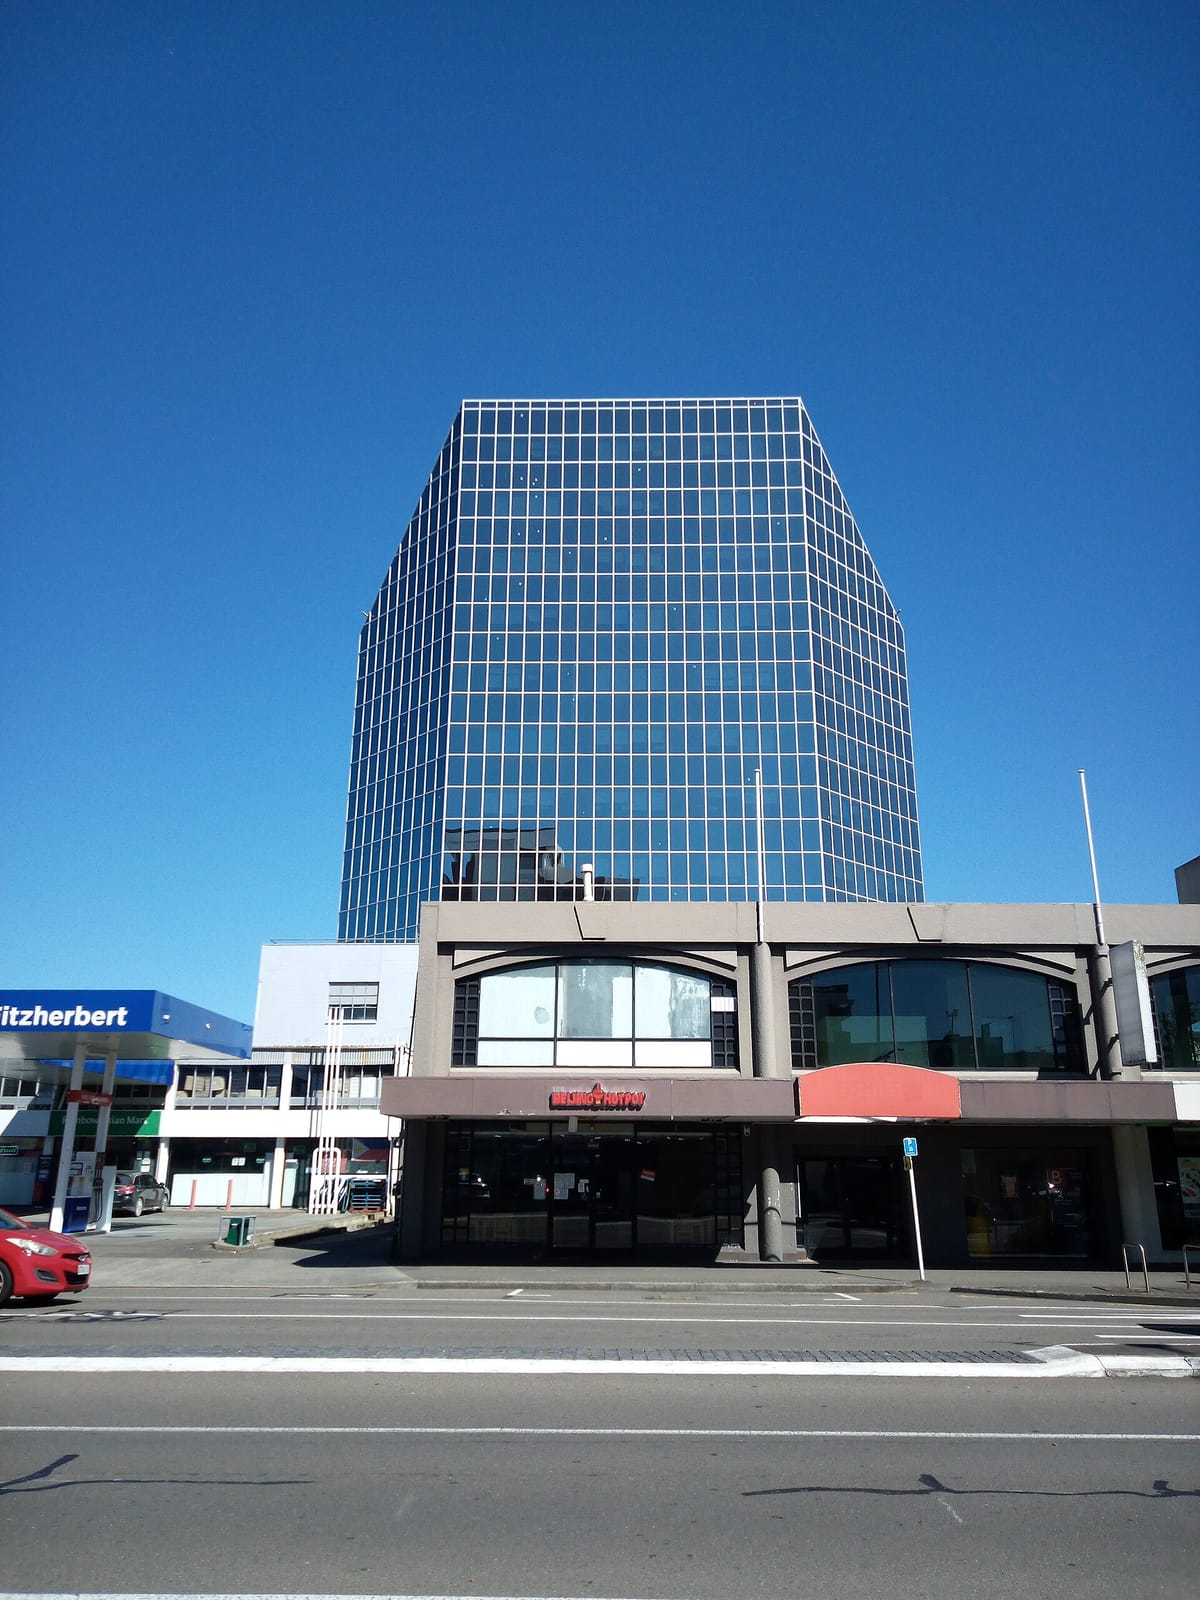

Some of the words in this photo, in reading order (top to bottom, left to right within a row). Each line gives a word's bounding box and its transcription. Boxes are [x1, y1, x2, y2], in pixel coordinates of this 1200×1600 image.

[0, 1005, 128, 1026] itzherbert
[551, 1092, 594, 1106] BEIJING
[603, 1091, 646, 1106] HOTPOT
